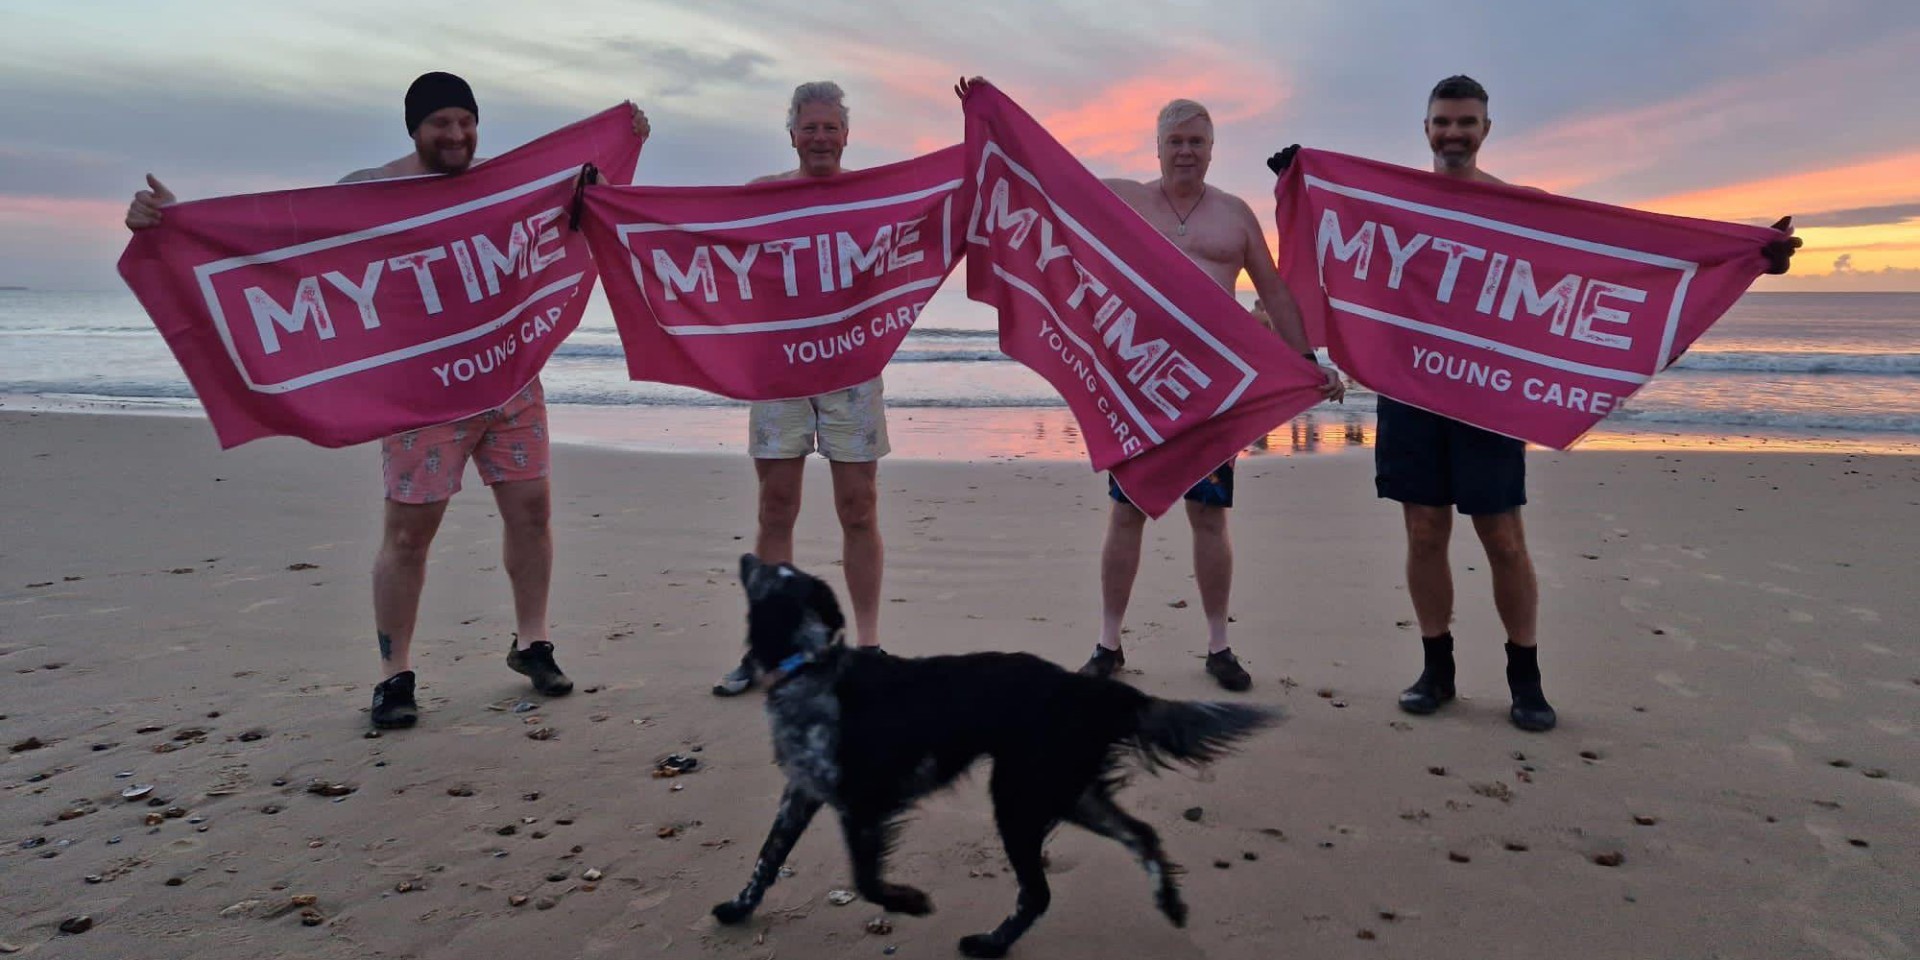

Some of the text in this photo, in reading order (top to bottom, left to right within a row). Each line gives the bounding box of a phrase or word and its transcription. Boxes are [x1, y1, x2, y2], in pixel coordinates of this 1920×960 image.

[244, 206, 568, 355] MYTIME
[652, 215, 928, 303] MYTIME
[986, 177, 1212, 422] MYTIME
[1317, 208, 1649, 351] MYTIME
[432, 333, 517, 388] YOUNG
[782, 325, 866, 364] YOUNG
[1038, 320, 1145, 460] YOUNG CARE
[1412, 345, 1513, 392] YOUNG
